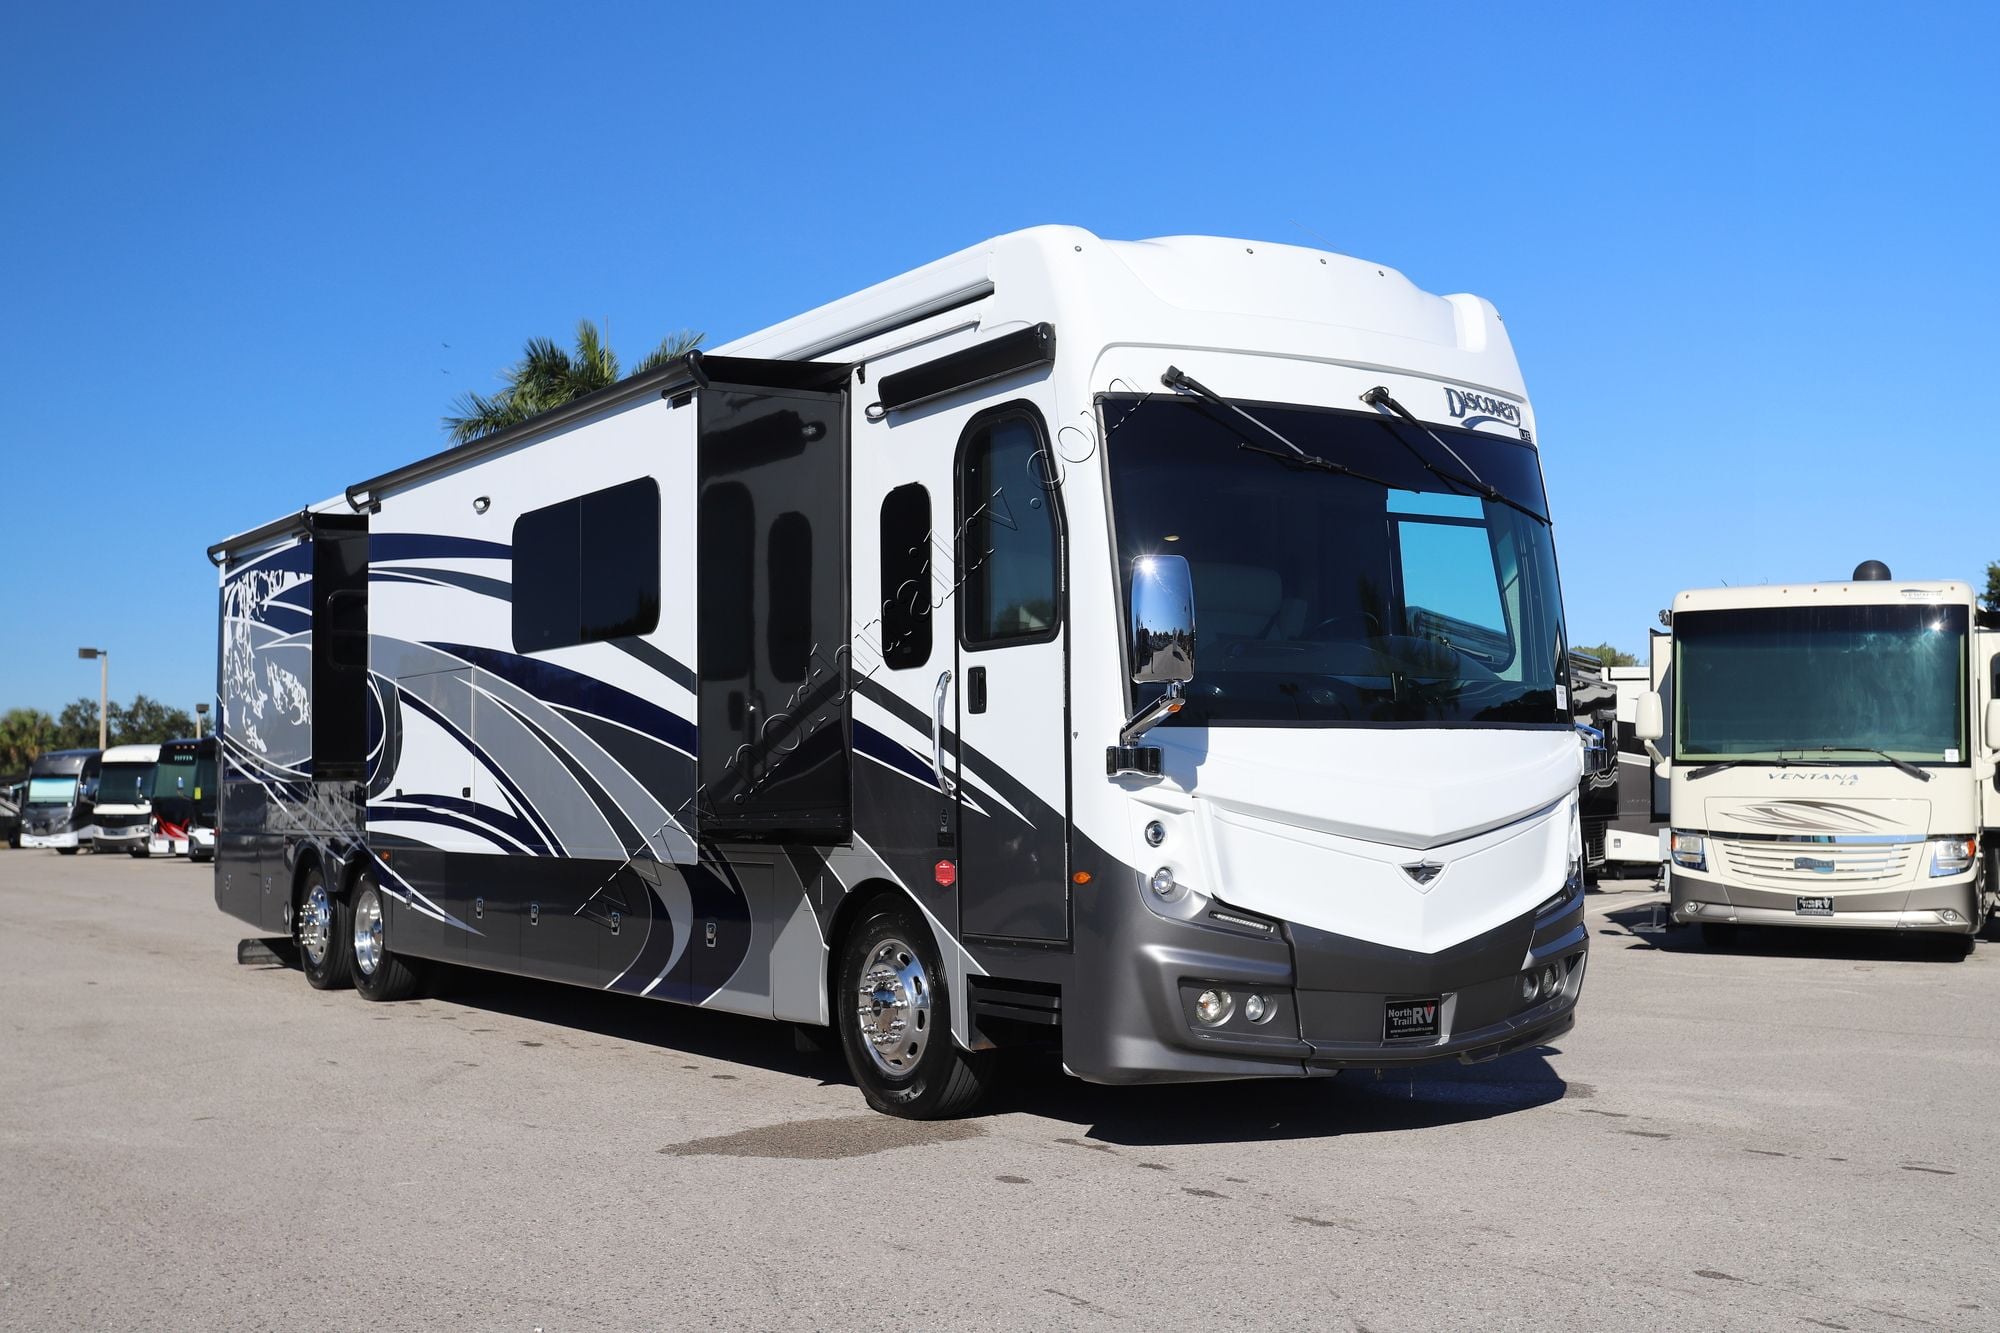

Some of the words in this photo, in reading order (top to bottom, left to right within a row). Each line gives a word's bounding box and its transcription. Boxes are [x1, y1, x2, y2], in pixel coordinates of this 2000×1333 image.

[1768, 772, 1859, 781] VENTANA
[1388, 1007, 1412, 1018] North
[1412, 1006, 1436, 1025] RV
[1392, 1017, 1412, 1026] Trail
